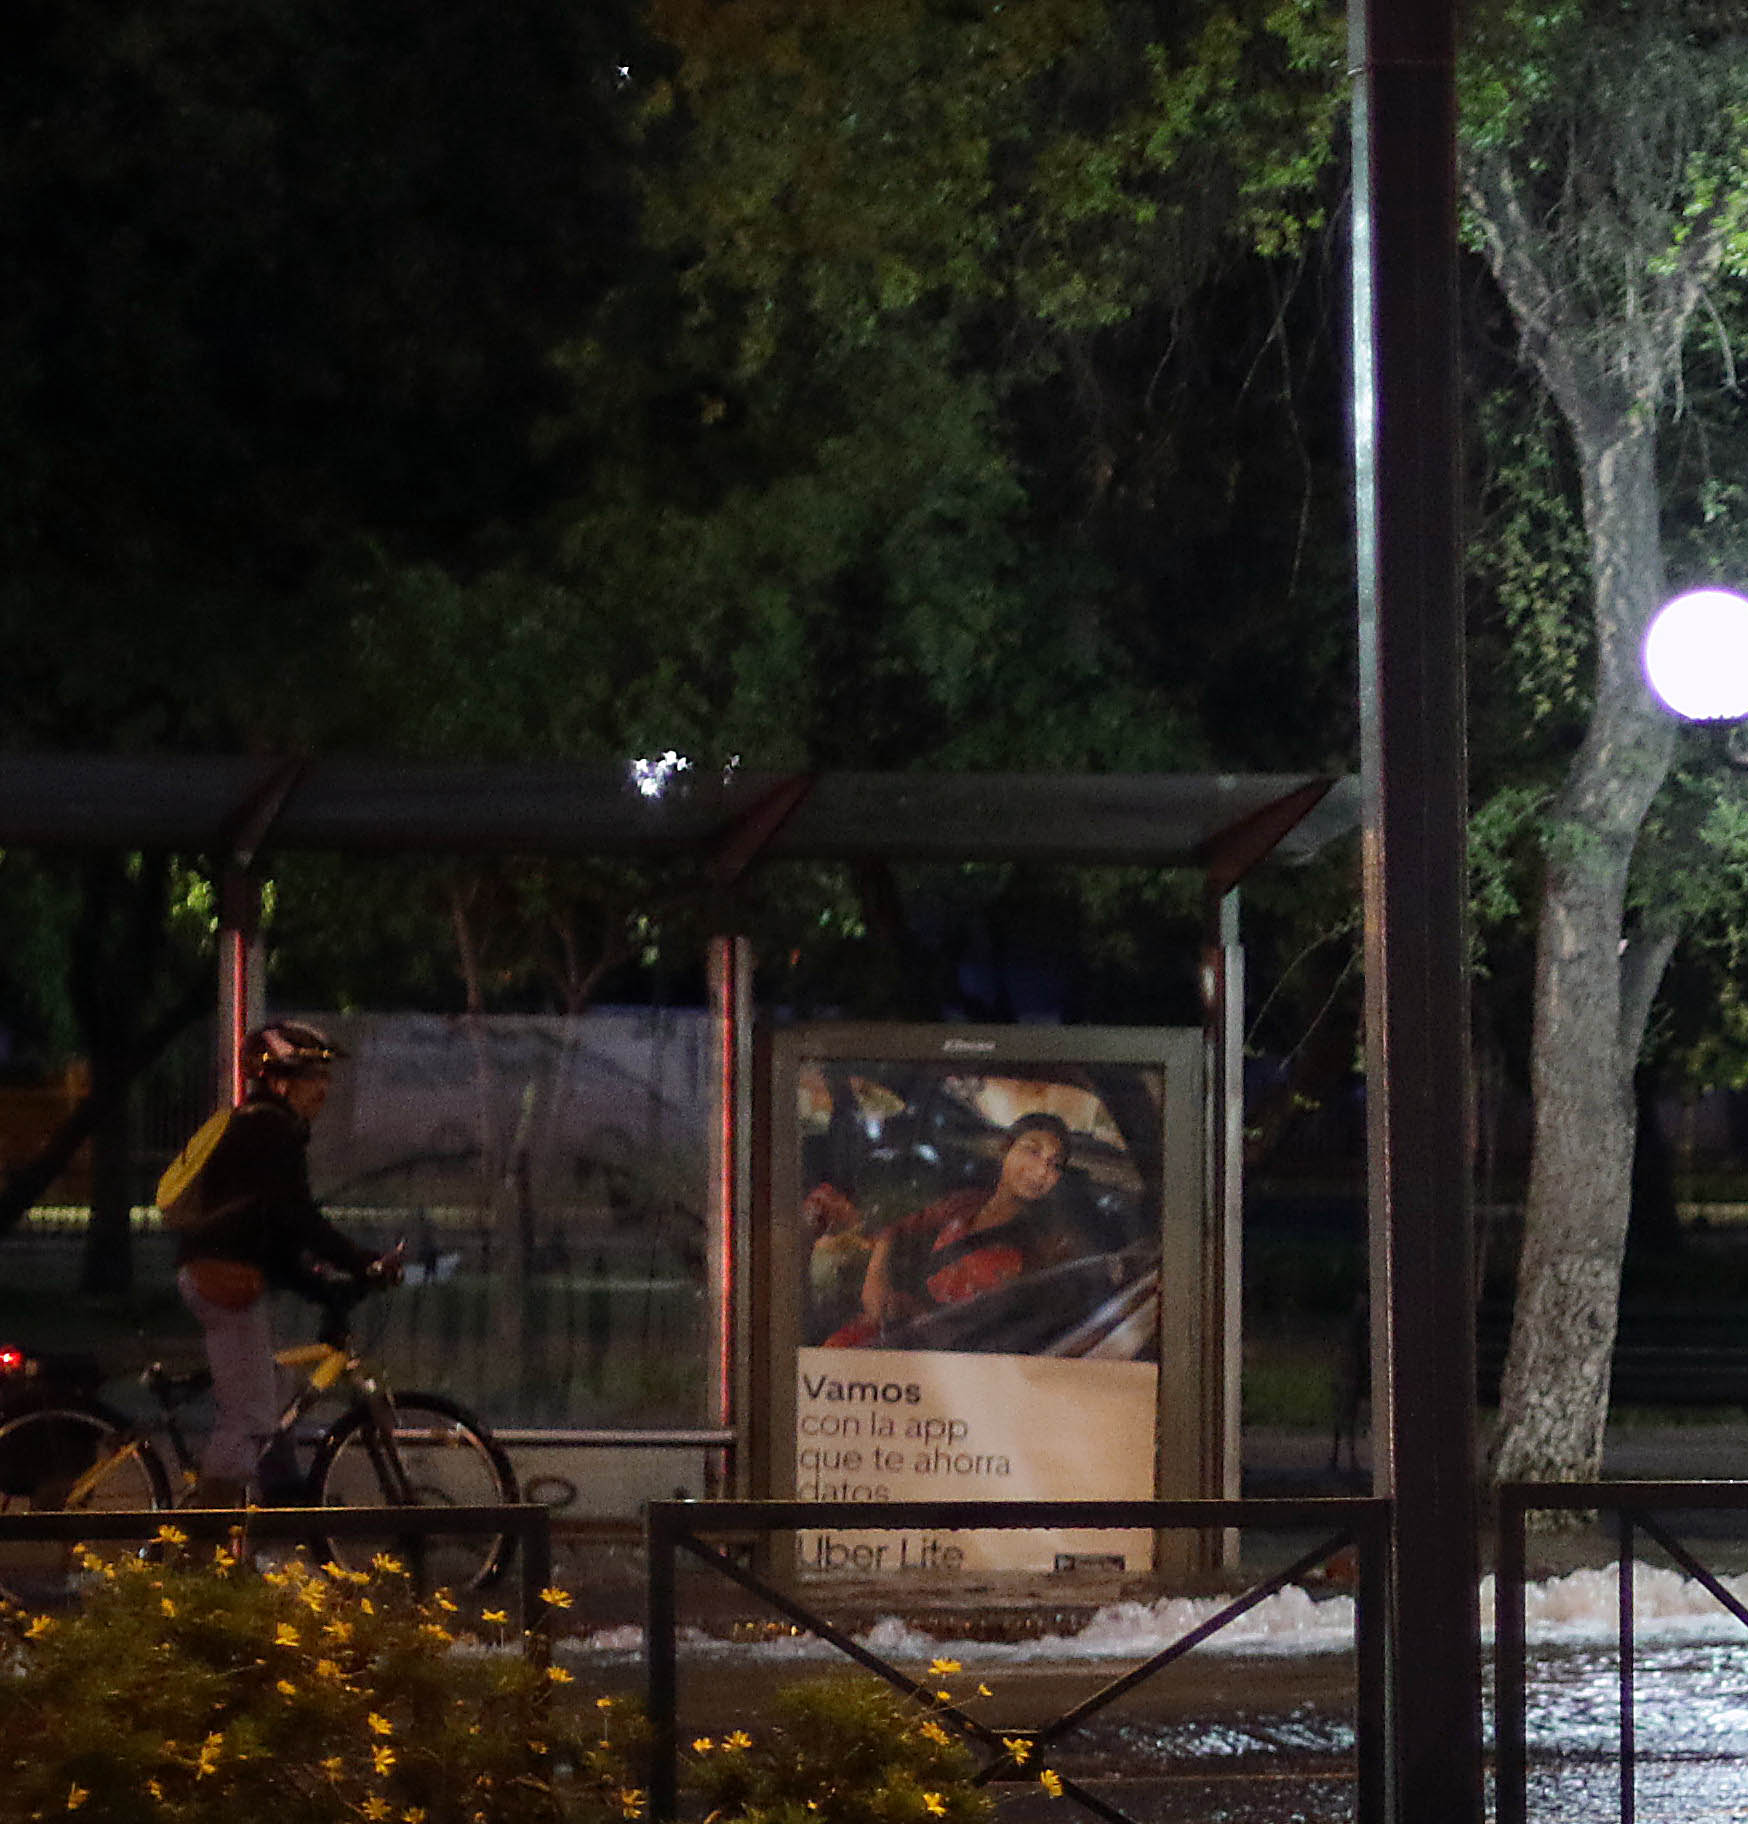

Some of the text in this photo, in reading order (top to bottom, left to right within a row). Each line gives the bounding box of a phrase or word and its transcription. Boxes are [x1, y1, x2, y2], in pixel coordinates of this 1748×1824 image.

[803, 1374, 921, 1404] Vamos
[801, 1411, 969, 1445] con la app
[801, 1445, 1011, 1479] que te ahorra
[901, 1536, 964, 1567] Lite
